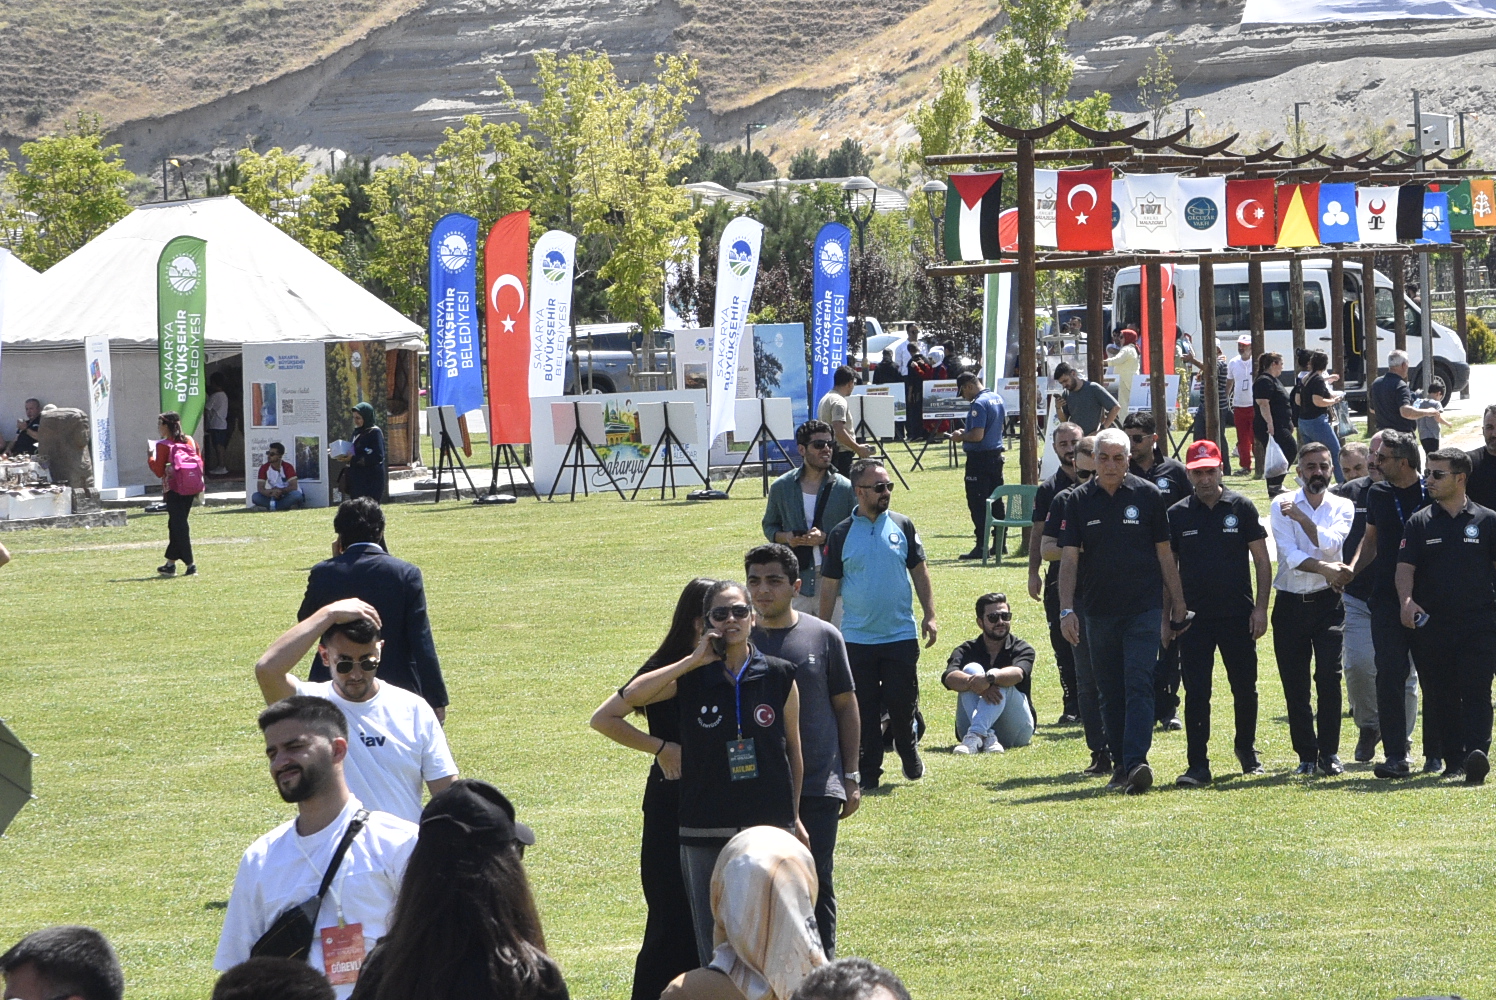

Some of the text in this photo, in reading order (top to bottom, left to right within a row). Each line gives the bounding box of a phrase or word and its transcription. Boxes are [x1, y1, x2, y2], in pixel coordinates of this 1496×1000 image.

[1140, 204, 1162, 214] 1071
[164, 321, 174, 390] SAKARYA
[174, 309, 187, 403] BÜYÜKŞEHİR
[188, 313, 202, 396] BELEDİYESİ
[443, 287, 459, 378] BÜYÜKŞEHİR
[456, 290, 474, 369] BELEDİYESİ
[533, 308, 545, 370] SAKARYA
[544, 298, 557, 382] BÜYÜKŞEHİR
[555, 301, 568, 377] BELEDİYESİ
[716, 306, 730, 378] SAKARYA
[814, 300, 824, 363] SAKARYA
[831, 293, 845, 369] BELEDİYESİ
[596, 451, 645, 483] Sakarya
[331, 957, 362, 974] GÖREVLİ
